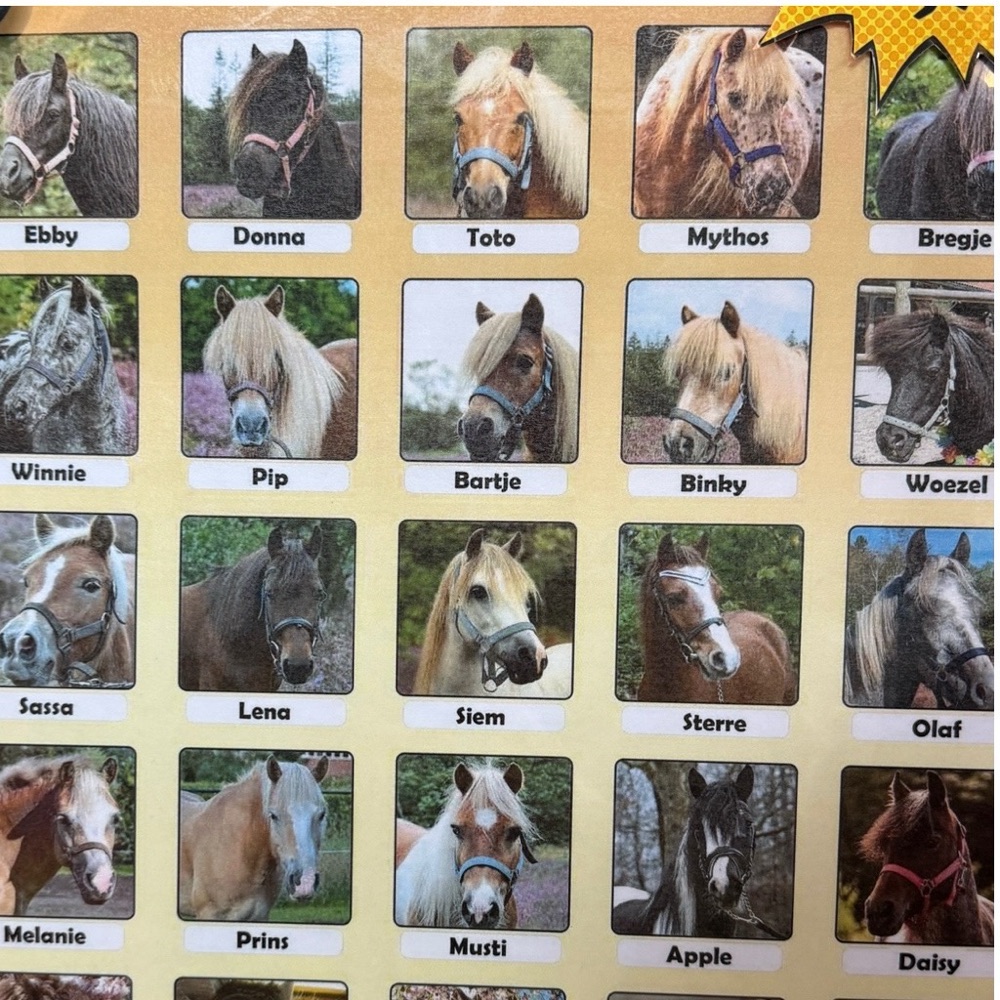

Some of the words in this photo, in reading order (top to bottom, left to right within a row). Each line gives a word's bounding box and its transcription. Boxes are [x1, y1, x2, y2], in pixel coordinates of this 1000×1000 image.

[25, 226, 78, 247] Ebby
[233, 227, 305, 246] Donna
[467, 228, 516, 247] Toto
[687, 227, 769, 249] Mythos
[918, 228, 992, 251] Bregje
[11, 463, 86, 482] Winnie
[252, 467, 289, 489] Pip
[454, 472, 522, 493] Bartje
[680, 474, 747, 496] Binky
[906, 474, 988, 494] Woezel
[19, 697, 74, 716] Sassa
[239, 702, 291, 720] Lena
[456, 707, 506, 726] Siem
[683, 713, 747, 732] Sterre
[912, 719, 962, 738] Olaf
[4, 926, 86, 945] Melanie
[237, 931, 289, 950] Prins
[449, 937, 507, 957] Musti
[666, 945, 733, 968] Apple
[898, 952, 961, 975] Daisy
